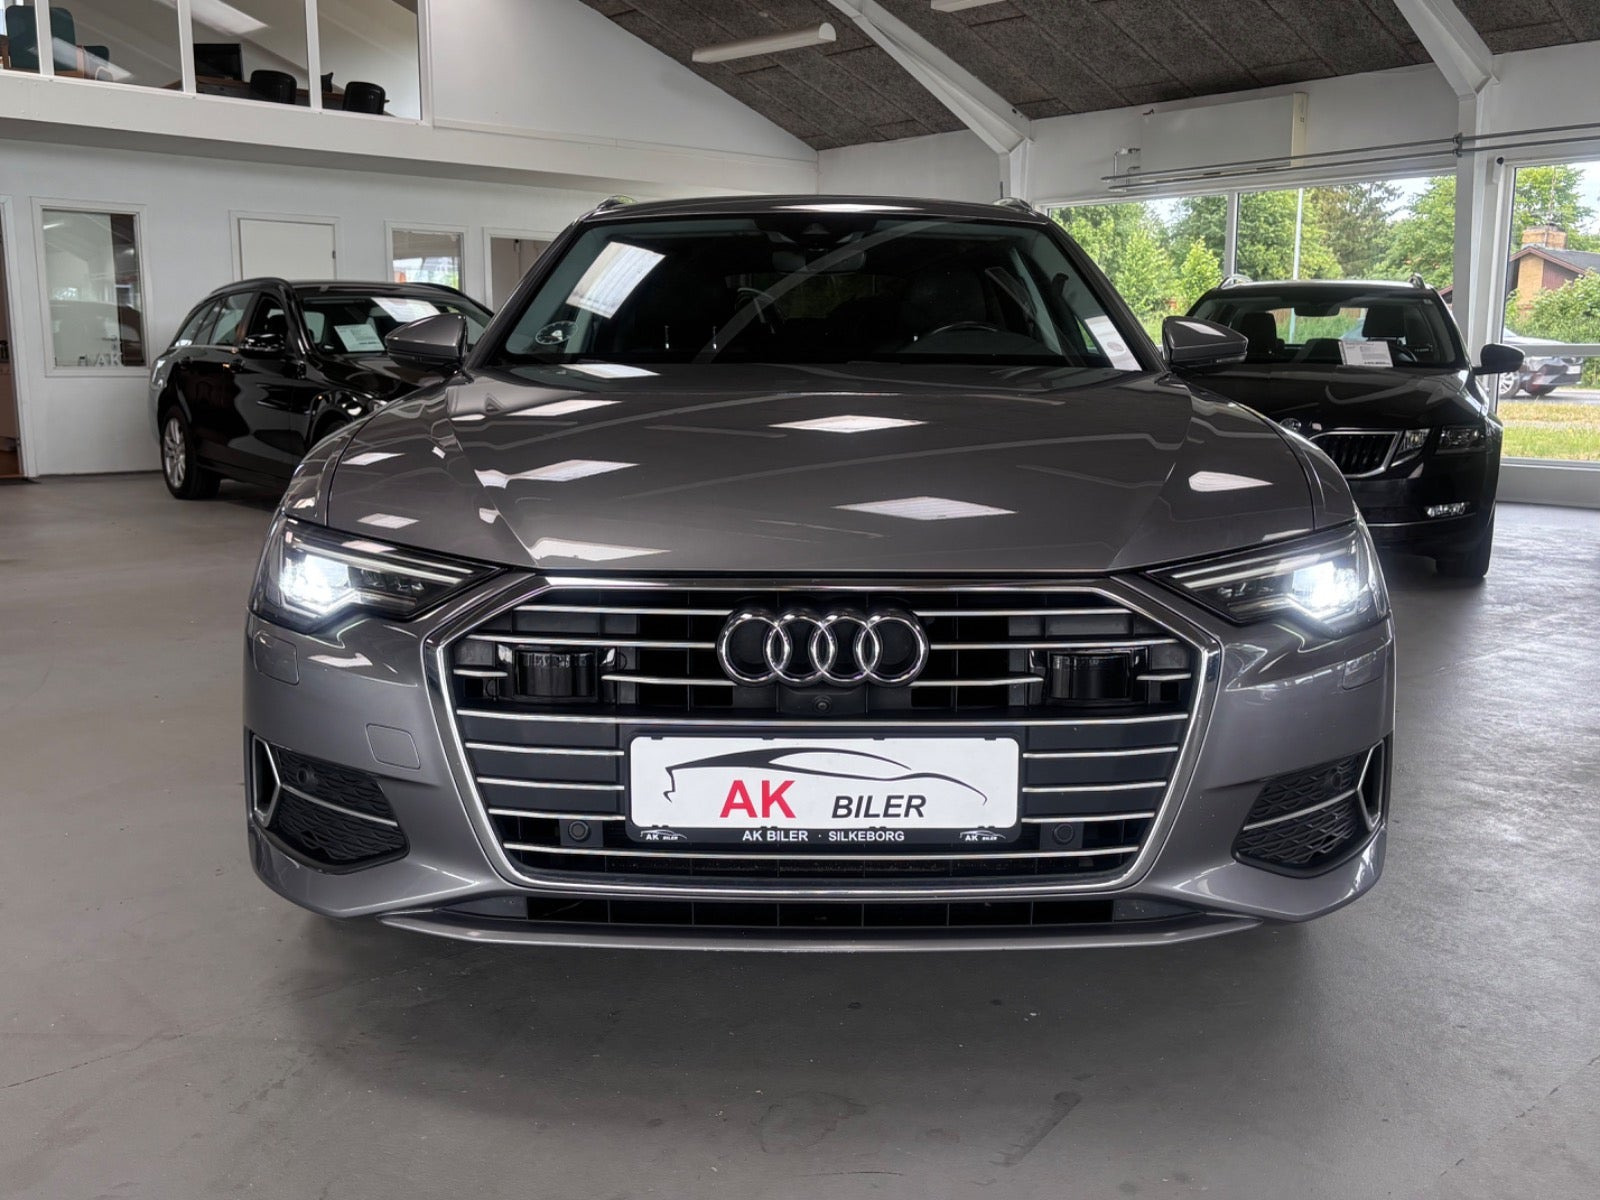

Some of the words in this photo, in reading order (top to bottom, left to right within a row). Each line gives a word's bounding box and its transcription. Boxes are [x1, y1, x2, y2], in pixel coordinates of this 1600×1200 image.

[719, 780, 797, 819] AK
[831, 794, 927, 819] BILER
[742, 830, 763, 842] AK
[766, 830, 809, 842] BILER
[828, 830, 905, 842] SILKEBORG
